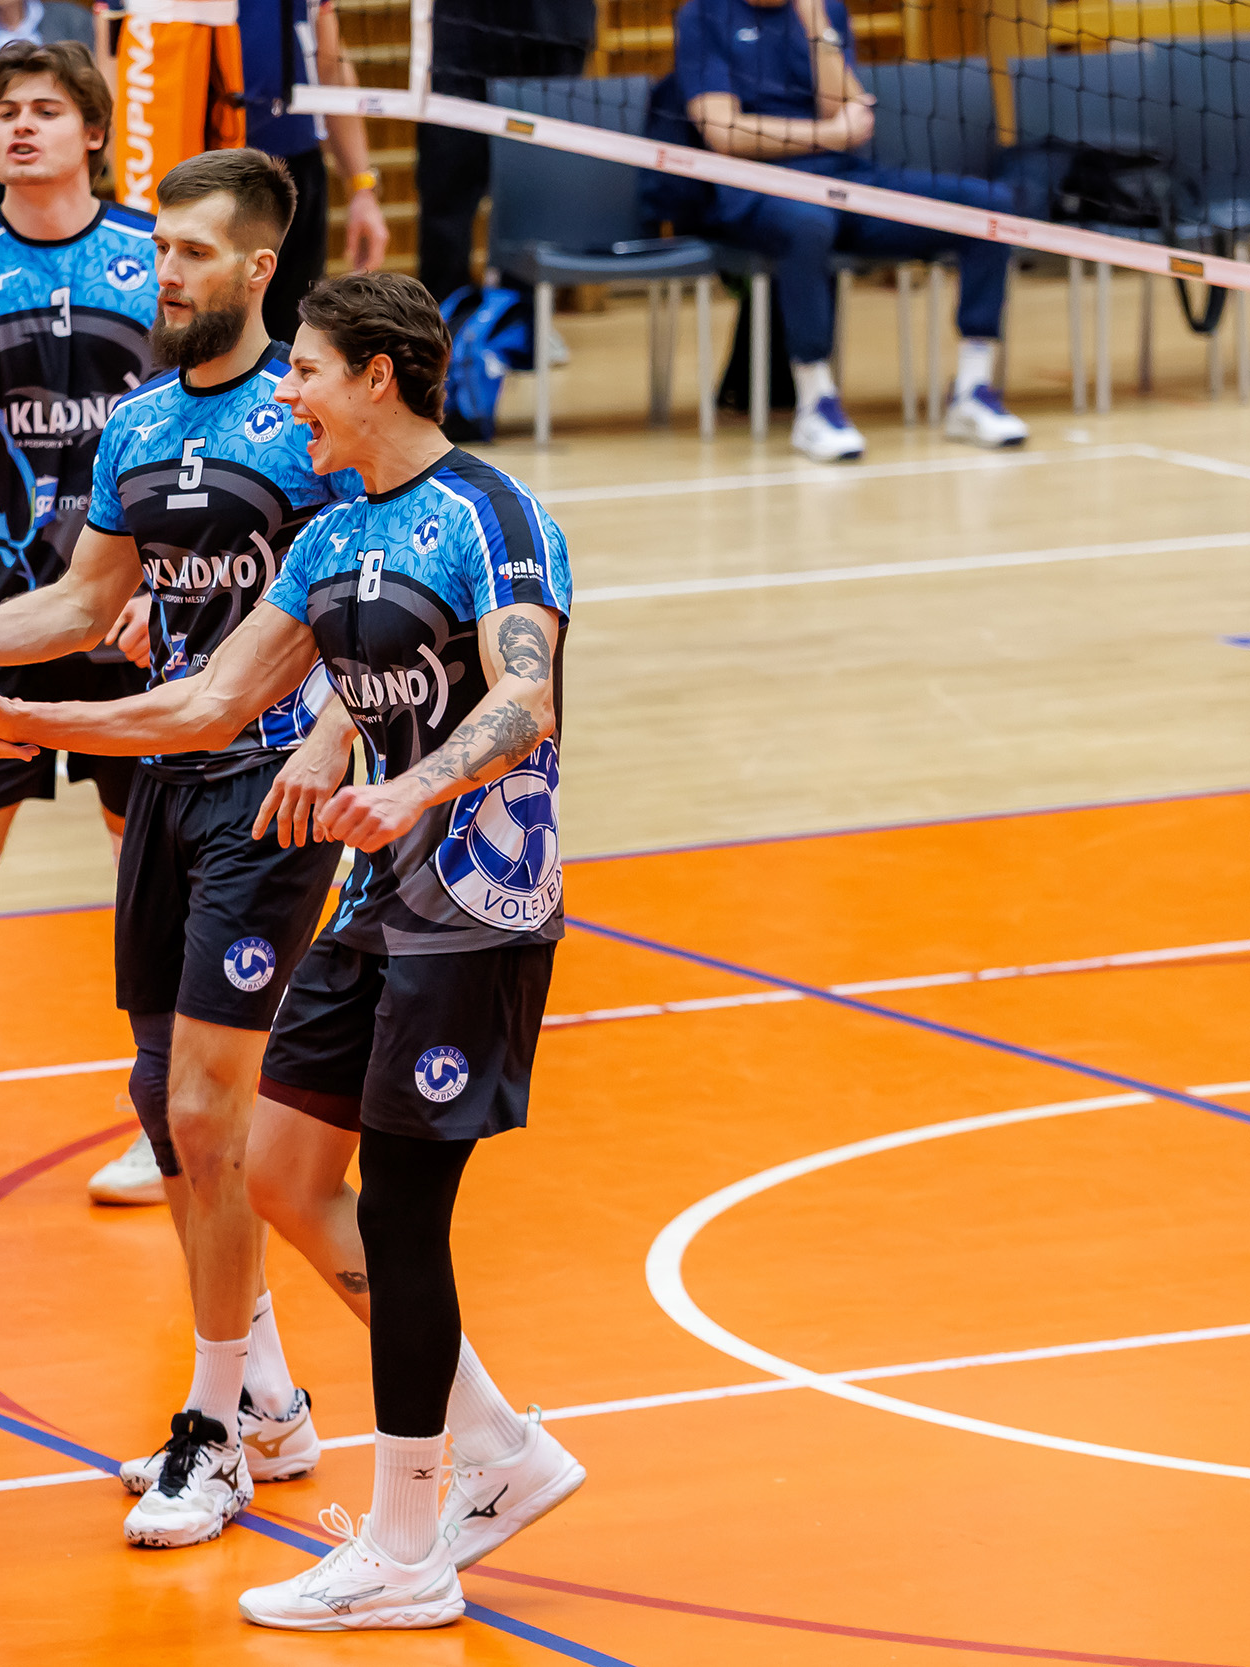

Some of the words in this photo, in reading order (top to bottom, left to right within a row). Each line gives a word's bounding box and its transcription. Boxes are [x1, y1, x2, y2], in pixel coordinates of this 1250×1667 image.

[50, 286, 72, 338] 3
[11, 394, 120, 435] KLADN
[178, 437, 205, 490] 5
[498, 558, 544, 580] gala
[422, 1048, 465, 1066] KLADNO
